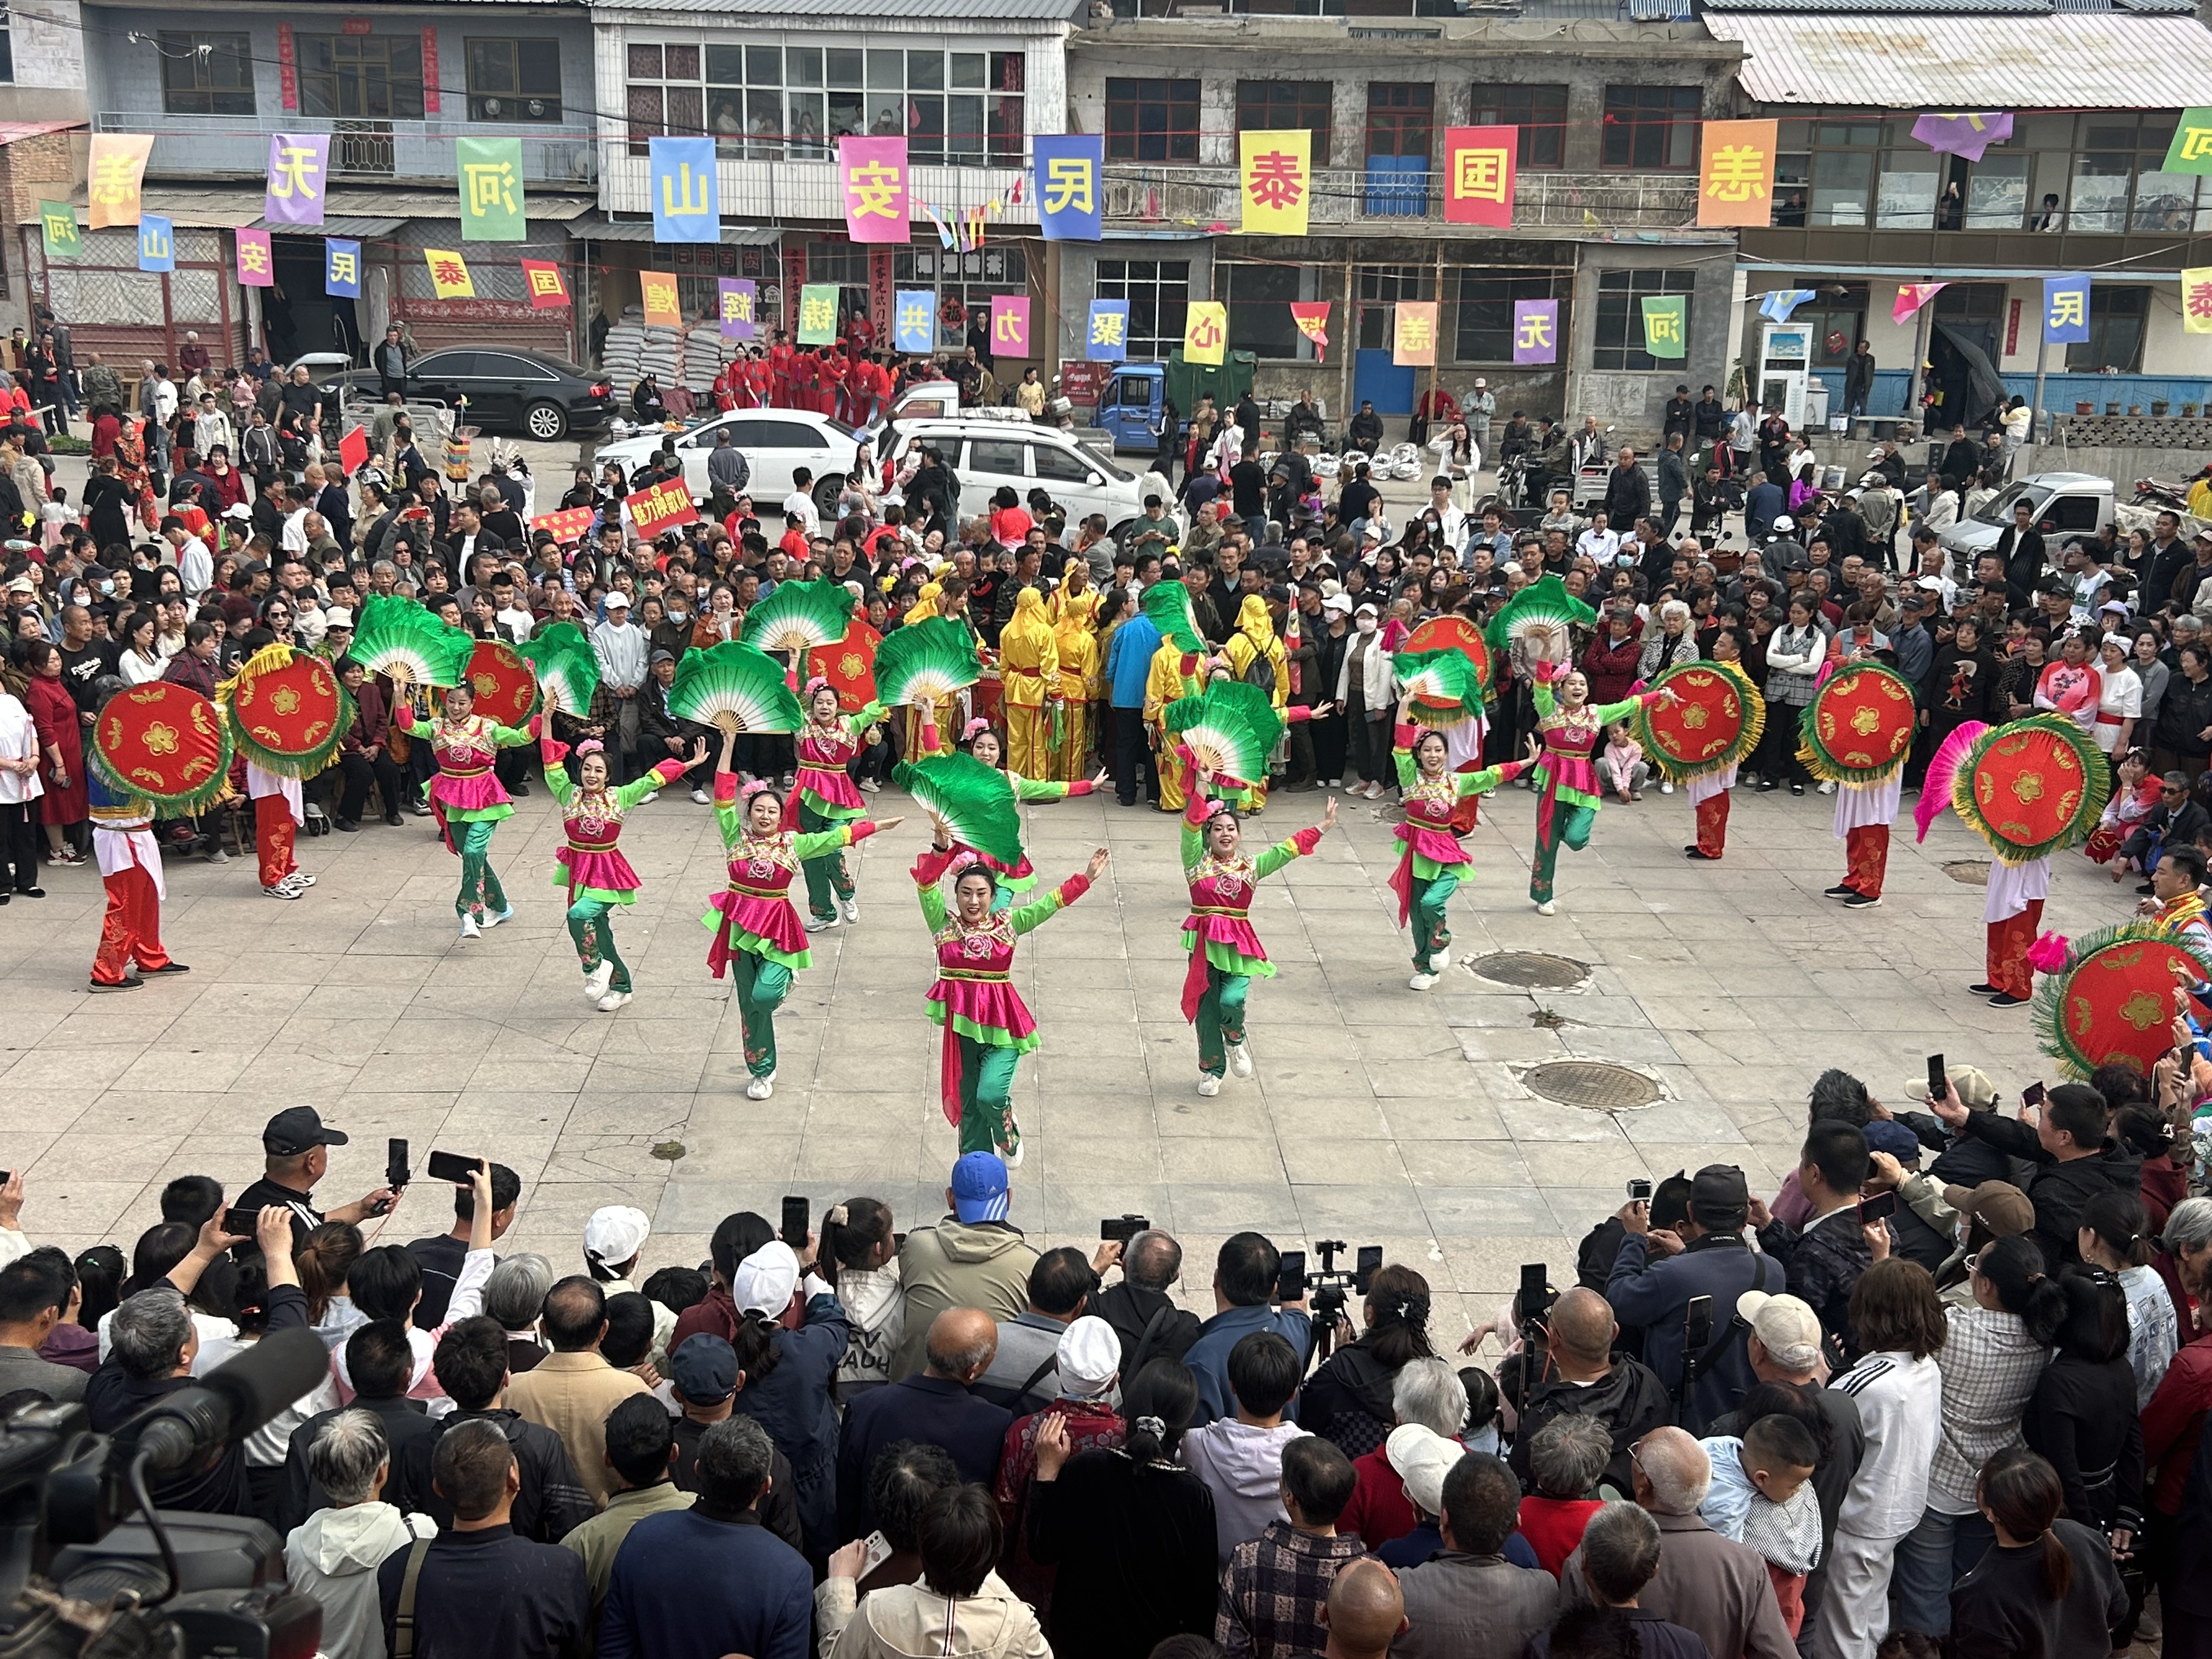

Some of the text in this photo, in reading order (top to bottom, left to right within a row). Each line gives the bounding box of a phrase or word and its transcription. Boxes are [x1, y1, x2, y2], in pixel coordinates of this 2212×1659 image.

[676, 249, 760, 270] 日用百货
[631, 487, 692, 527] 魅力秧歌队
[838, 1350, 890, 1374] AUH
